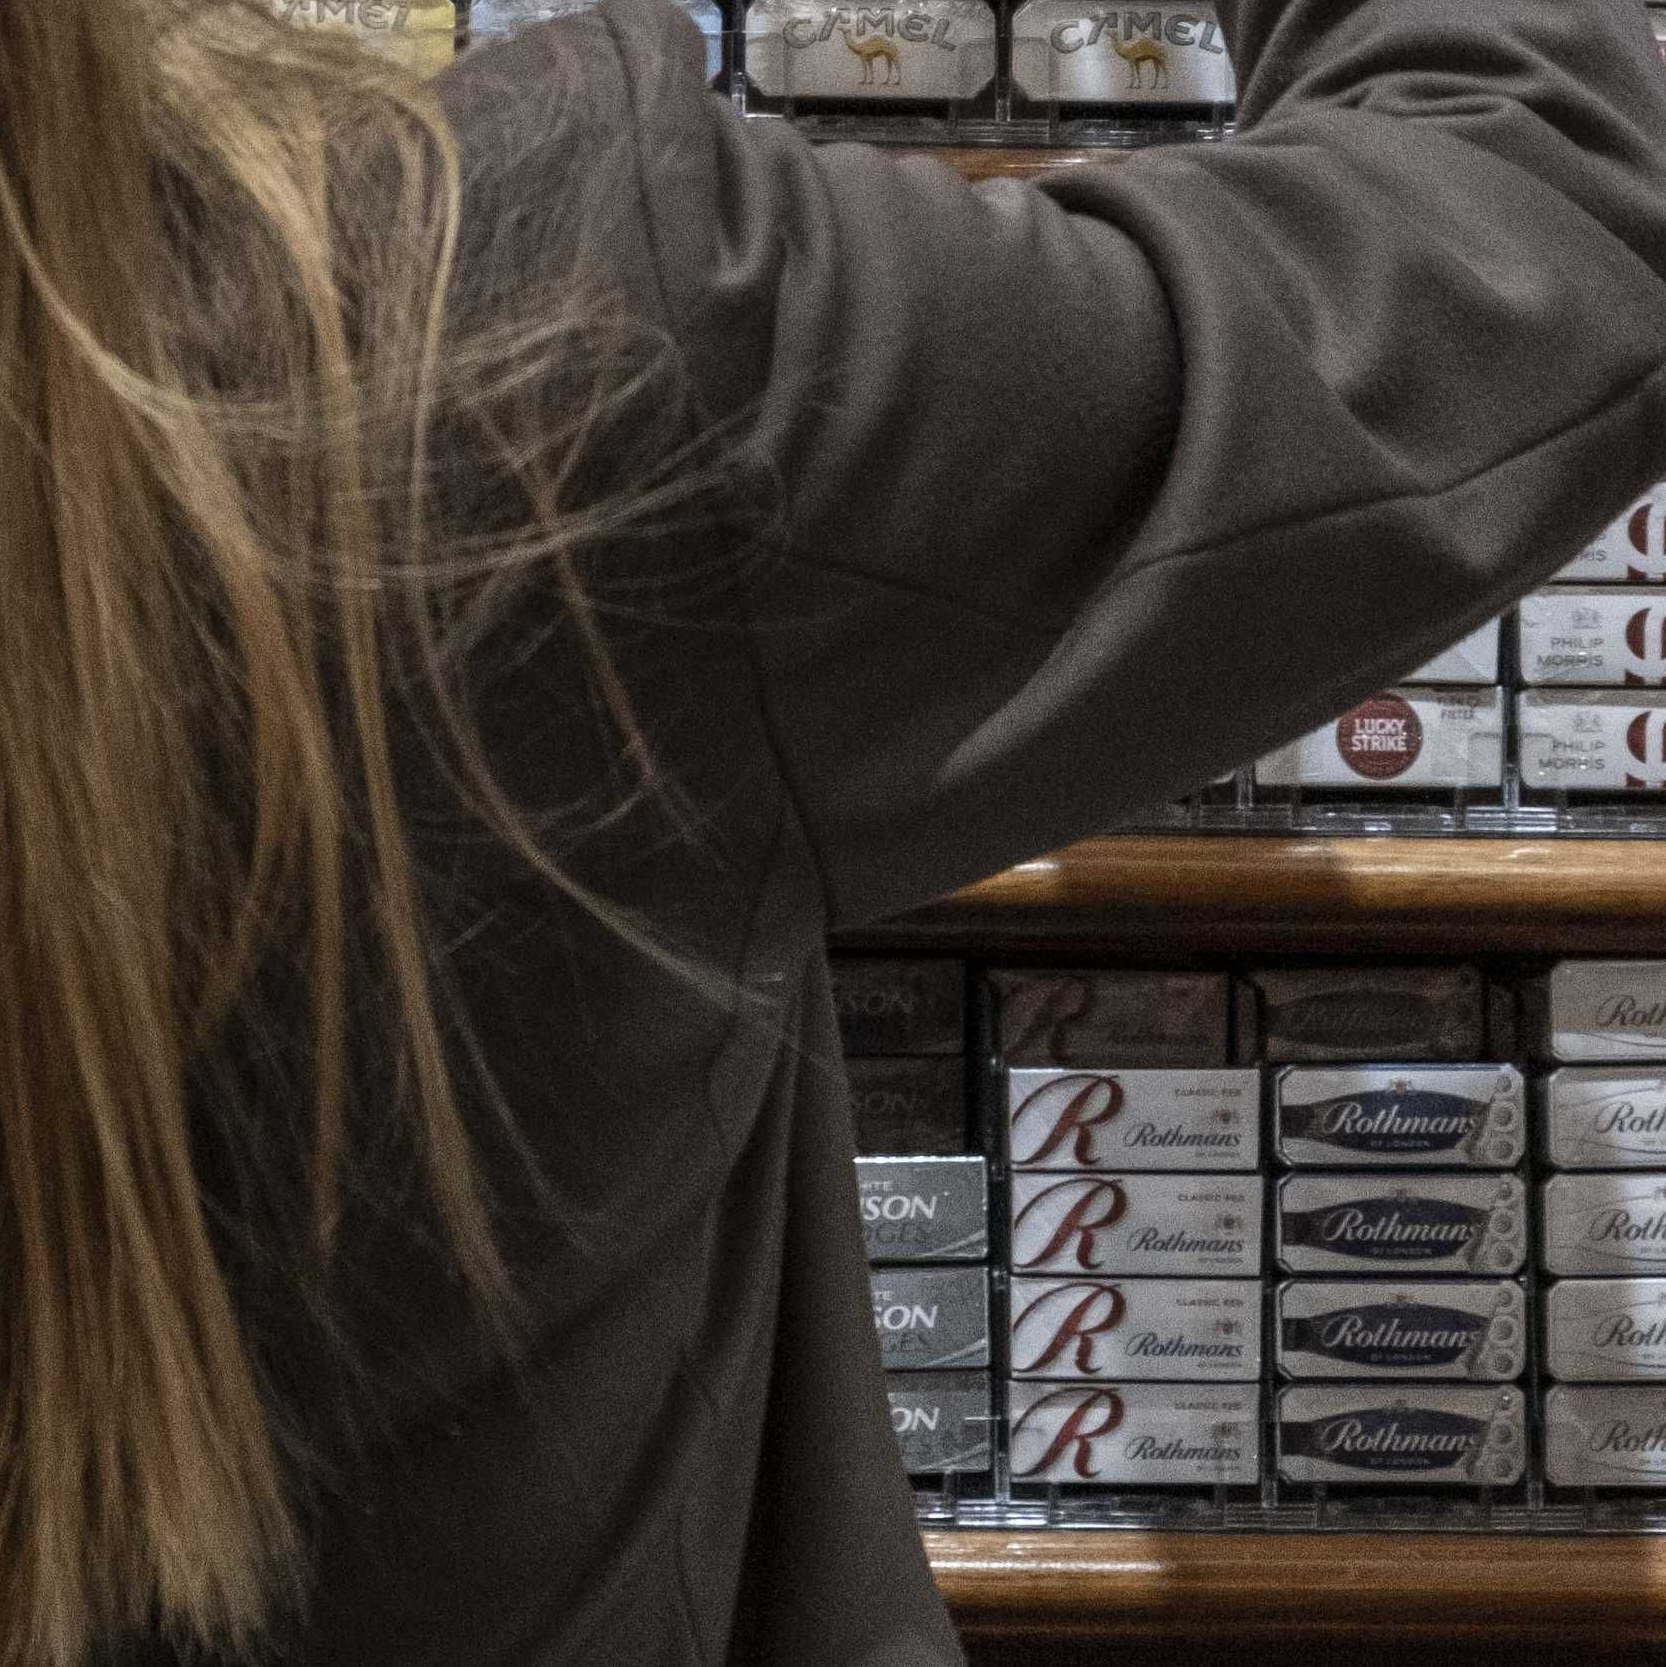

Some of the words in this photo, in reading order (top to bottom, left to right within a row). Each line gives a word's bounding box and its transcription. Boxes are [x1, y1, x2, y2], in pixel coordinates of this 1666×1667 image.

[782, 5, 959, 52] CAMEL
[1049, 8, 1225, 57] CAMEL
[1549, 636, 1606, 651] PHILIP
[1536, 652, 1606, 669] MORRIS
[1353, 716, 1409, 737] LUCKY
[1351, 734, 1409, 753] STRIKE
[1322, 1105, 1479, 1136] Rothmans
[1123, 1122, 1242, 1152] Rothmans
